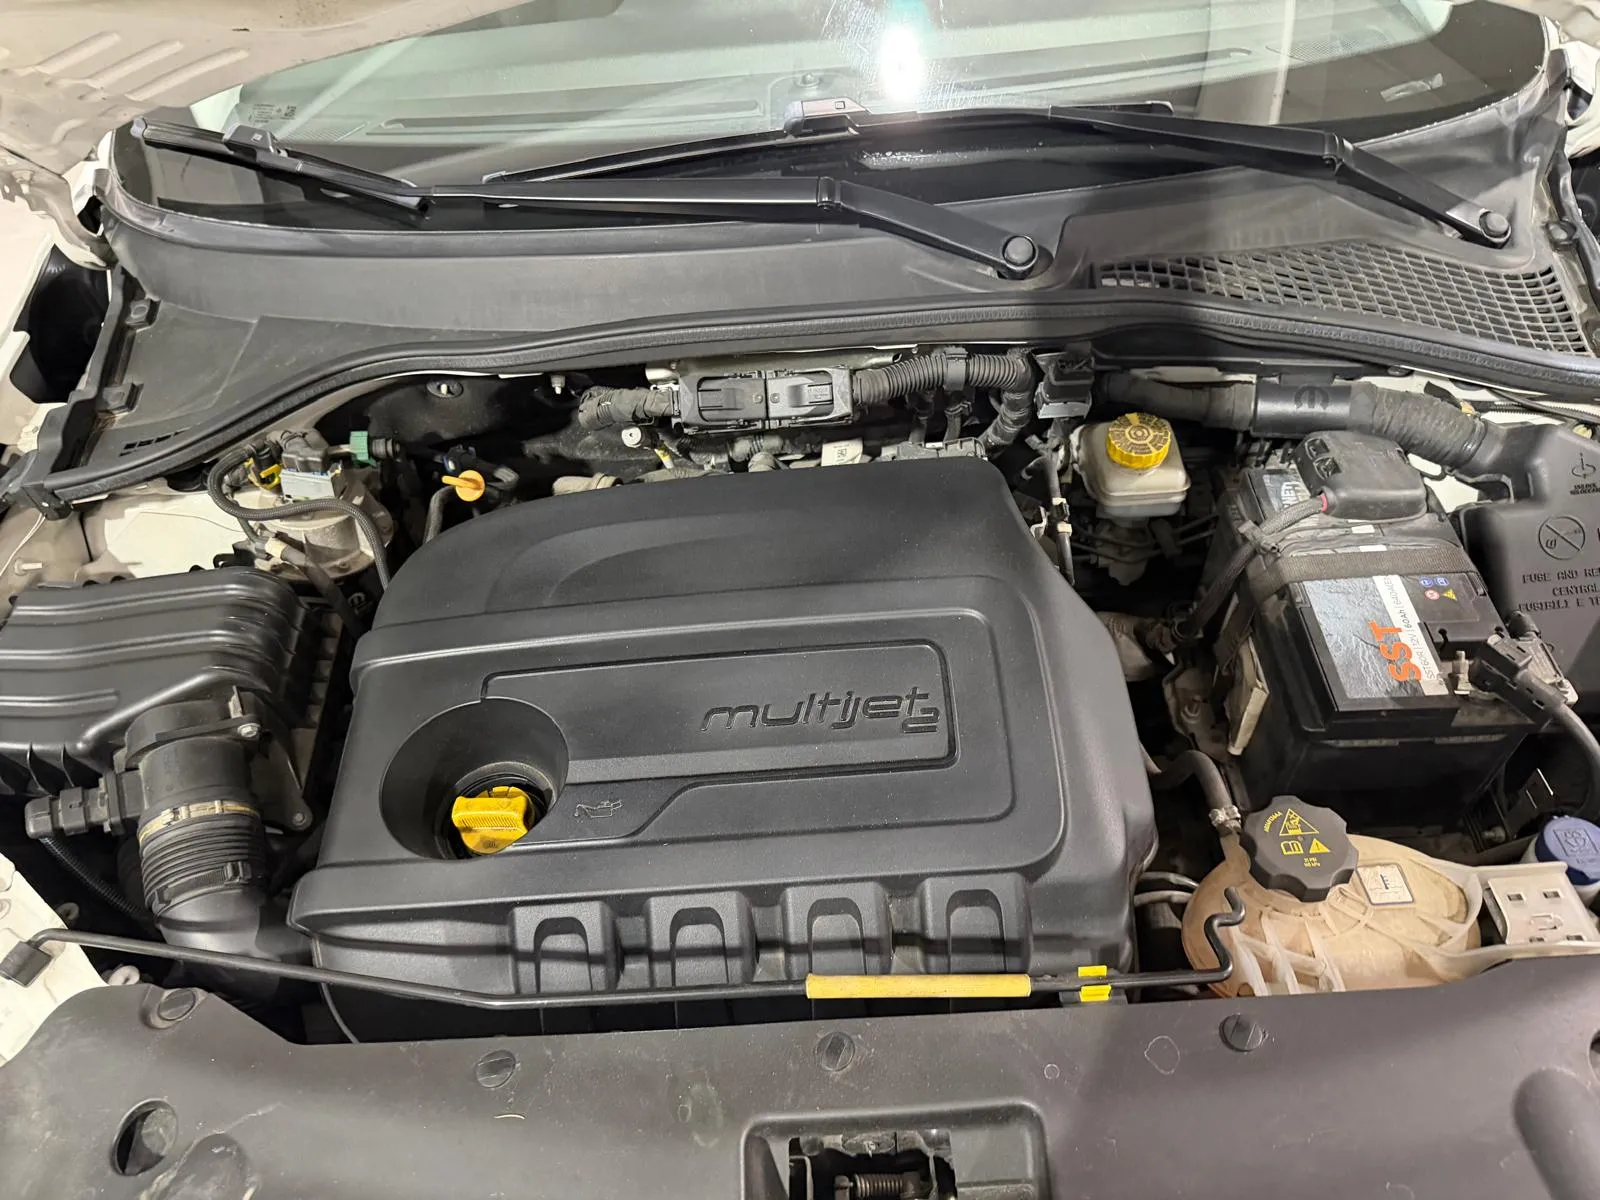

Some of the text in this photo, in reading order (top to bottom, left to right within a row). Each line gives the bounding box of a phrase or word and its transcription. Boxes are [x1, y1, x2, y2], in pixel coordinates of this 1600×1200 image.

[1522, 567, 1600, 584] FUSE AND RE
[1368, 620, 1422, 682] SST
[700, 686, 930, 731] multijet
